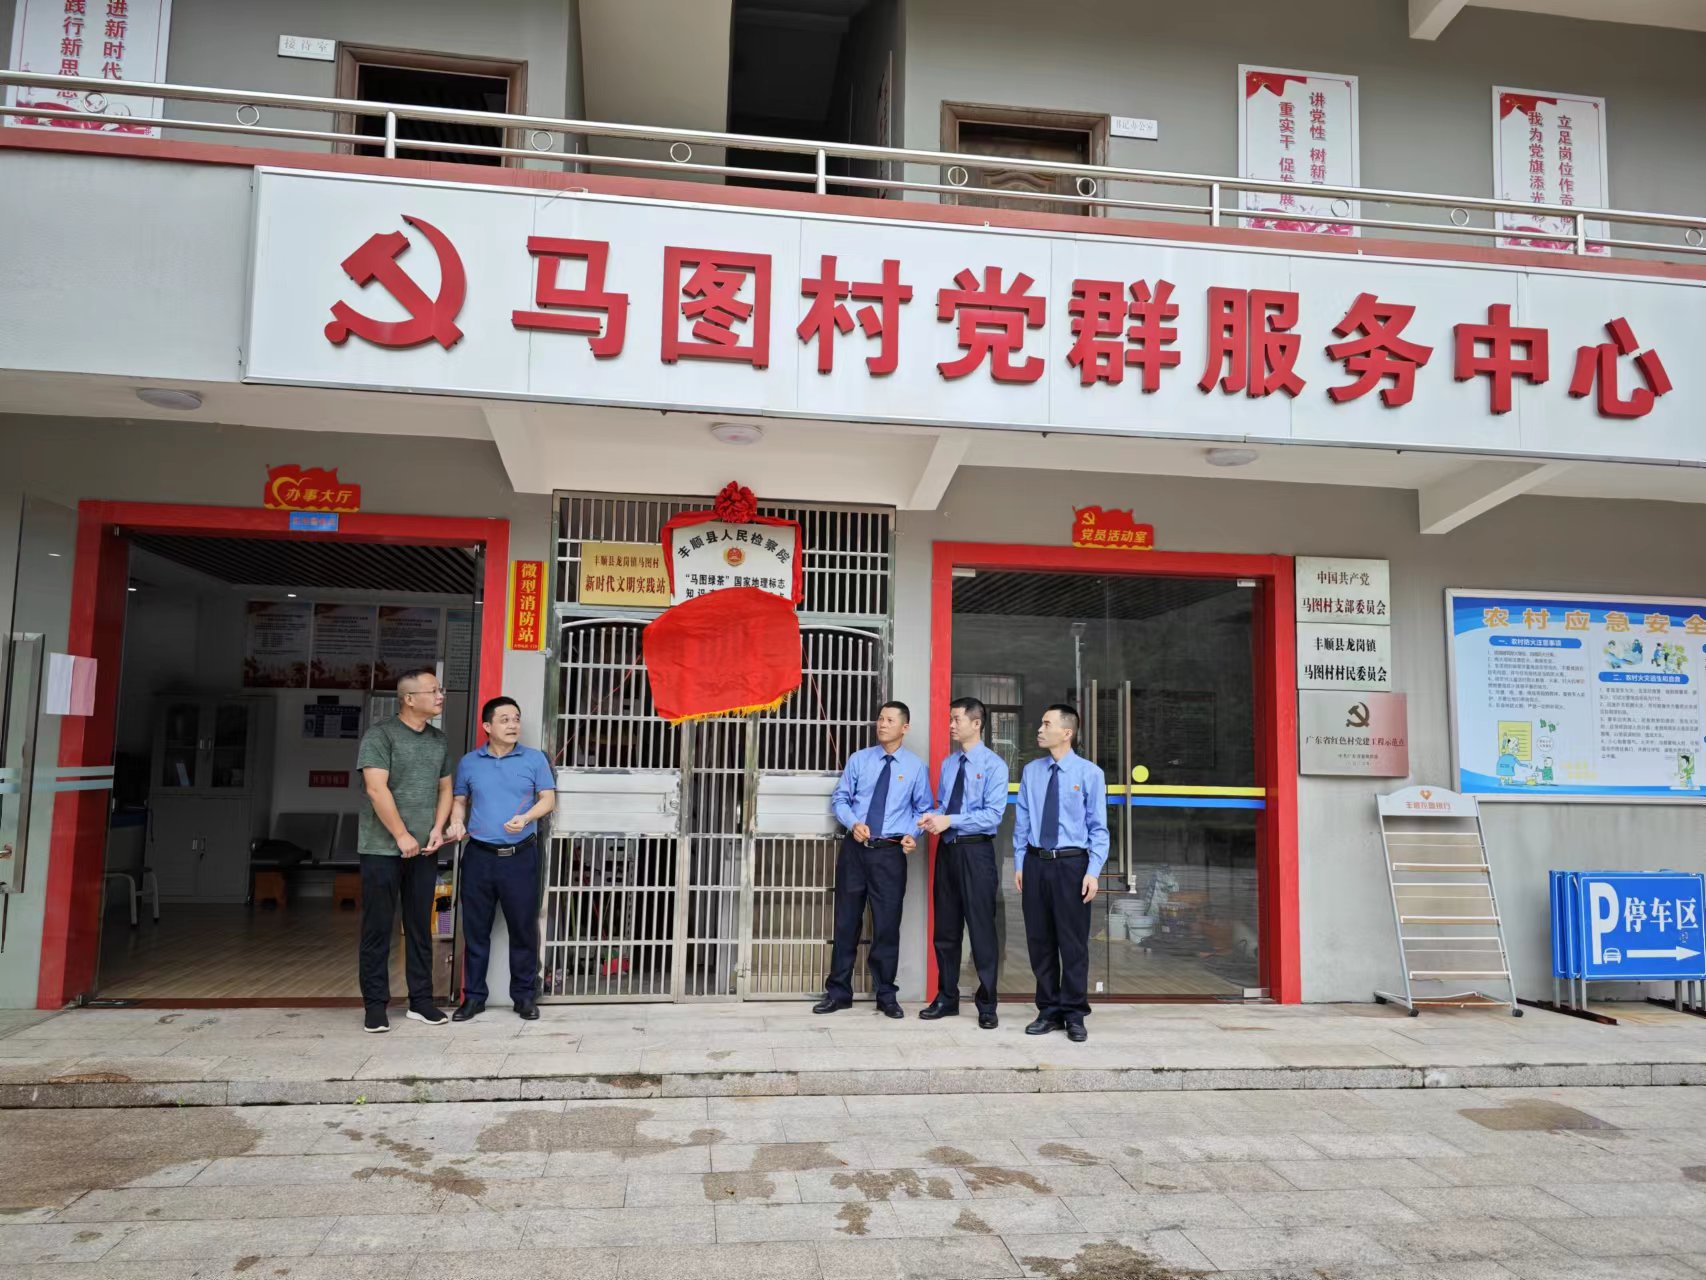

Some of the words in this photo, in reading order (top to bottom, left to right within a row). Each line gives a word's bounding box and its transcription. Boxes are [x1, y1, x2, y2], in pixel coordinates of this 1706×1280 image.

[102, 0, 128, 80] 进新时代
[1278, 101, 1295, 150] 重实干
[1309, 92, 1326, 141] 讲党性
[1309, 147, 1326, 184] 树新
[511, 236, 1672, 419] 马图村党群服务中心
[284, 487, 353, 504] 办事大厅
[677, 529, 791, 564] 丰顺县人民检察院
[1081, 528, 1148, 544] 党员活动室
[594, 554, 659, 569] 丰顺县龙岗镇马图村
[585, 574, 666, 594] 新时代文明实践站
[1316, 570, 1371, 586] 中国共产党
[516, 562, 538, 643] 微型消防站
[1301, 598, 1386, 616] 马图村支部委员会
[1483, 607, 1706, 636] 农村应急安全
[1313, 637, 1377, 653] 丰顺县龙岗镇
[1303, 664, 1388, 683] 马图村村民委员会
[1305, 736, 1405, 747] 广东省红色村党建工程示范点
[1589, 882, 1620, 965] P
[1623, 896, 1699, 933] 停车区
